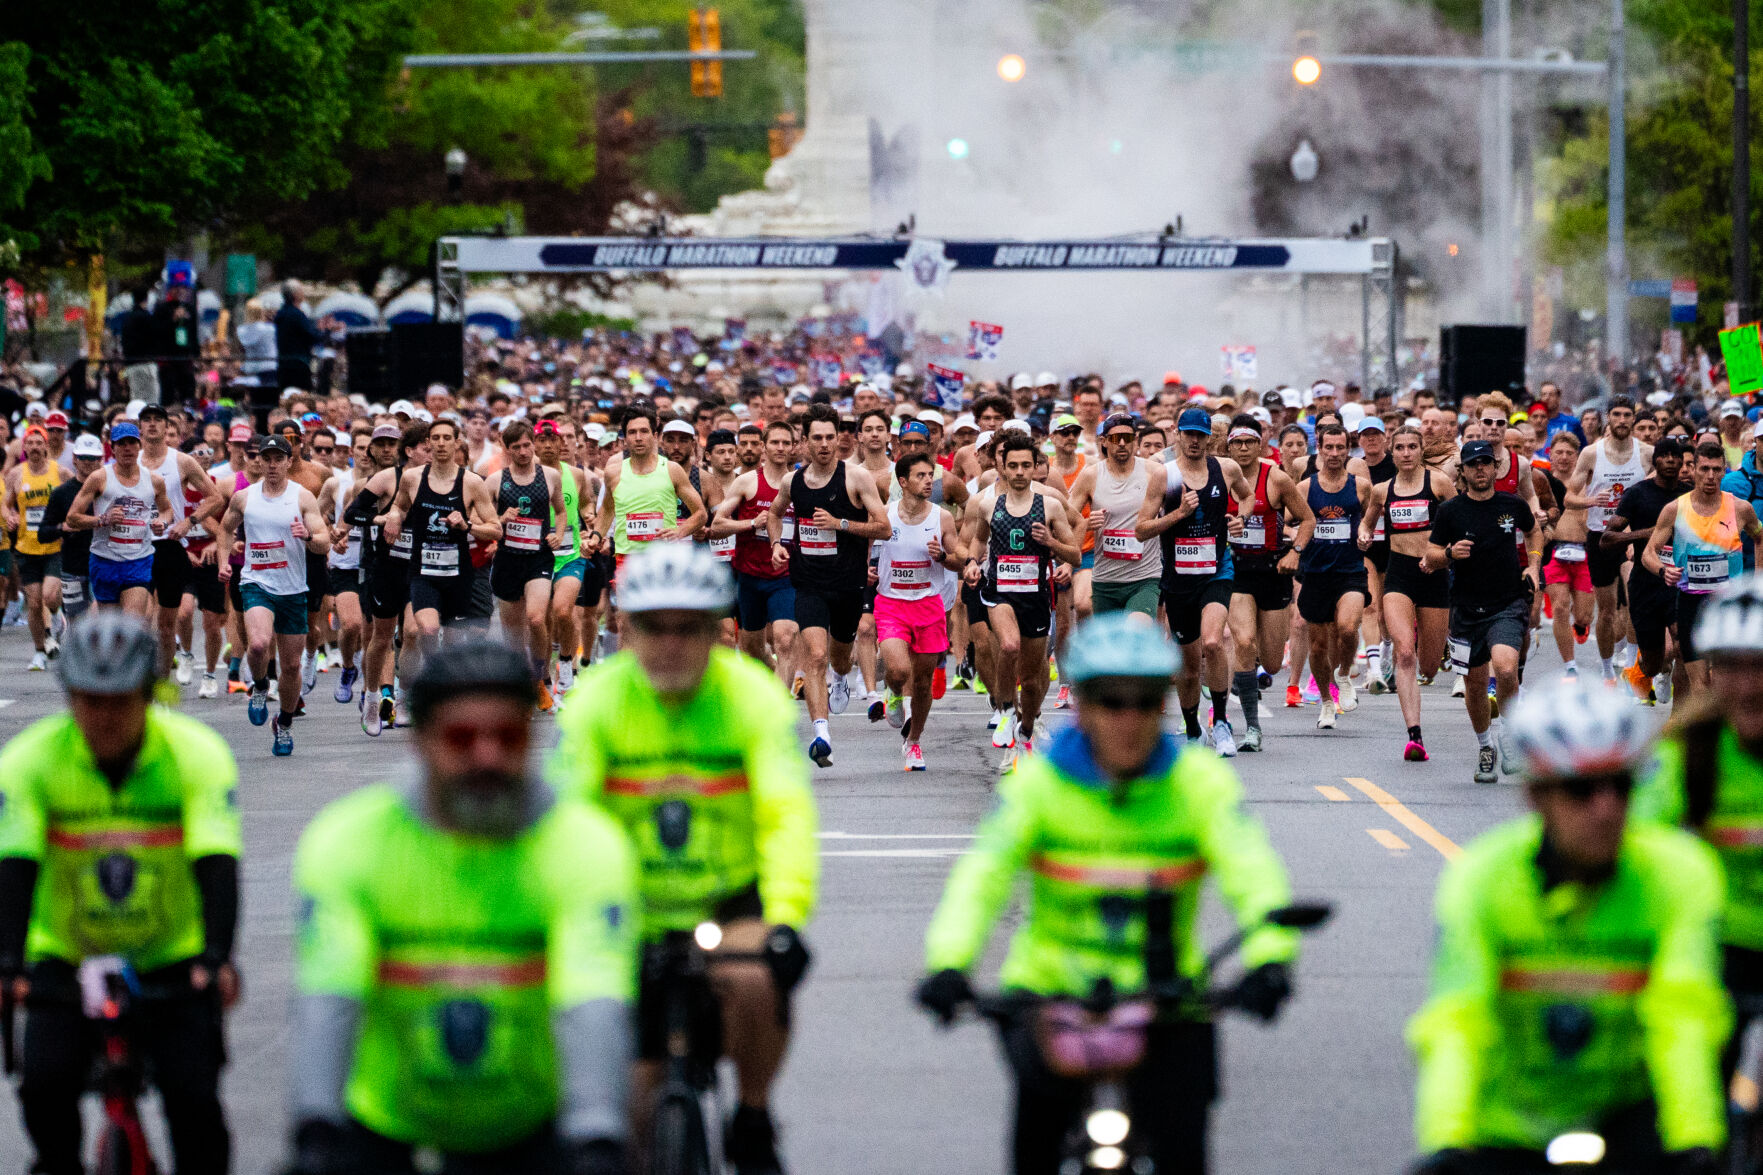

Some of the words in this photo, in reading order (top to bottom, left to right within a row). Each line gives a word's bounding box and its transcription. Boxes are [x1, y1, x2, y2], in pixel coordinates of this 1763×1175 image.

[593, 245, 667, 265] BUFFALO
[667, 245, 760, 265] MARATHON
[761, 245, 838, 265] WEEKEND
[994, 245, 1068, 266] BUFFALO
[1067, 245, 1159, 266] MARATHON
[1161, 245, 1238, 266] WEEKEND
[518, 496, 531, 514] C
[1391, 508, 1412, 517] 5538
[507, 523, 527, 532] 4427
[627, 521, 648, 529] 4176
[800, 526, 818, 536] 5809
[1316, 526, 1335, 534] 1650
[1009, 528, 1025, 550] C
[1104, 537, 1126, 547] 4241
[251, 550, 269, 559] 3061
[1176, 546, 1199, 555] 6588
[425, 551, 441, 560] 817
[999, 564, 1021, 573] 6455
[1689, 564, 1711, 572] 1673
[891, 569, 914, 578] 3302
